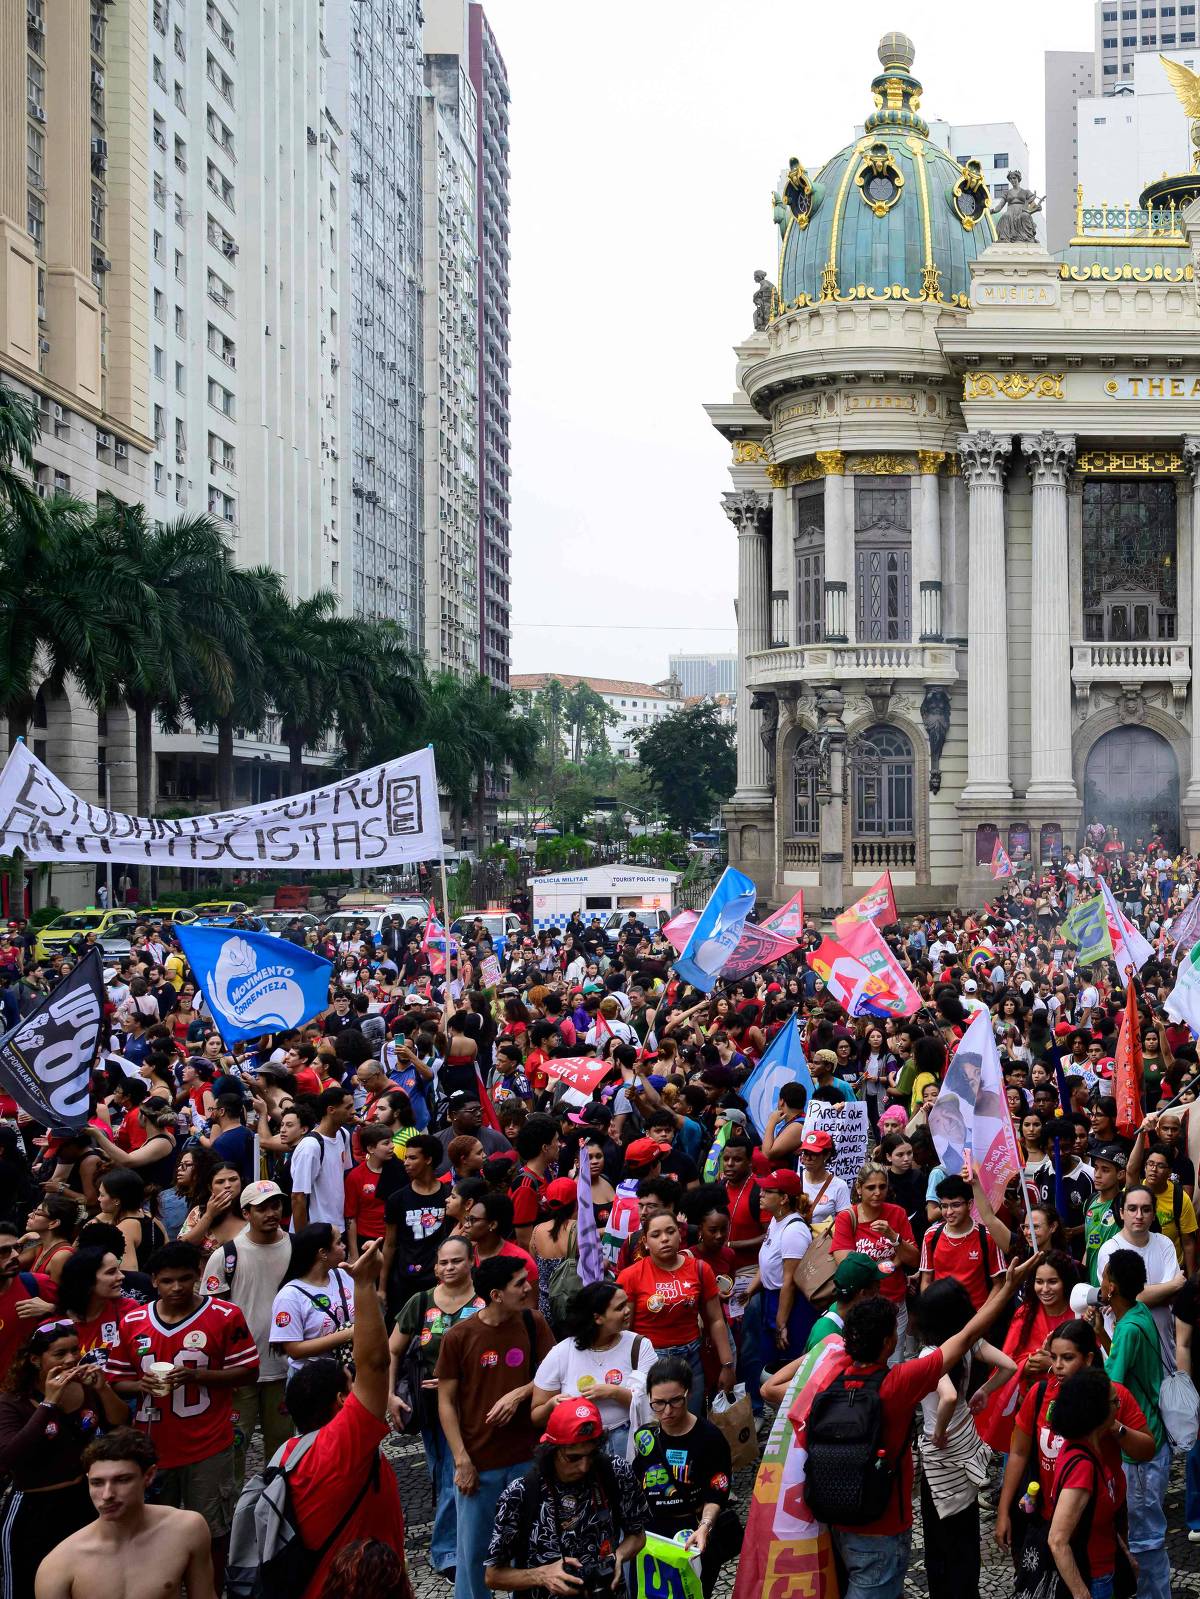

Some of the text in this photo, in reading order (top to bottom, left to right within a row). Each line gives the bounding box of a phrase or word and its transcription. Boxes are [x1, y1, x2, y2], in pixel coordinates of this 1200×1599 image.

[232, 965, 295, 1003] MOVIMENTO
[234, 981, 288, 1015] CORRENTEZA
[9, 1054, 33, 1088] POPULAR
[809, 1102, 863, 1120] PARECE QUE
[813, 1122, 862, 1133] LIBERARAM
[831, 1134, 867, 1144] ECONCEITO,
[1089, 1234, 1100, 1244] 55
